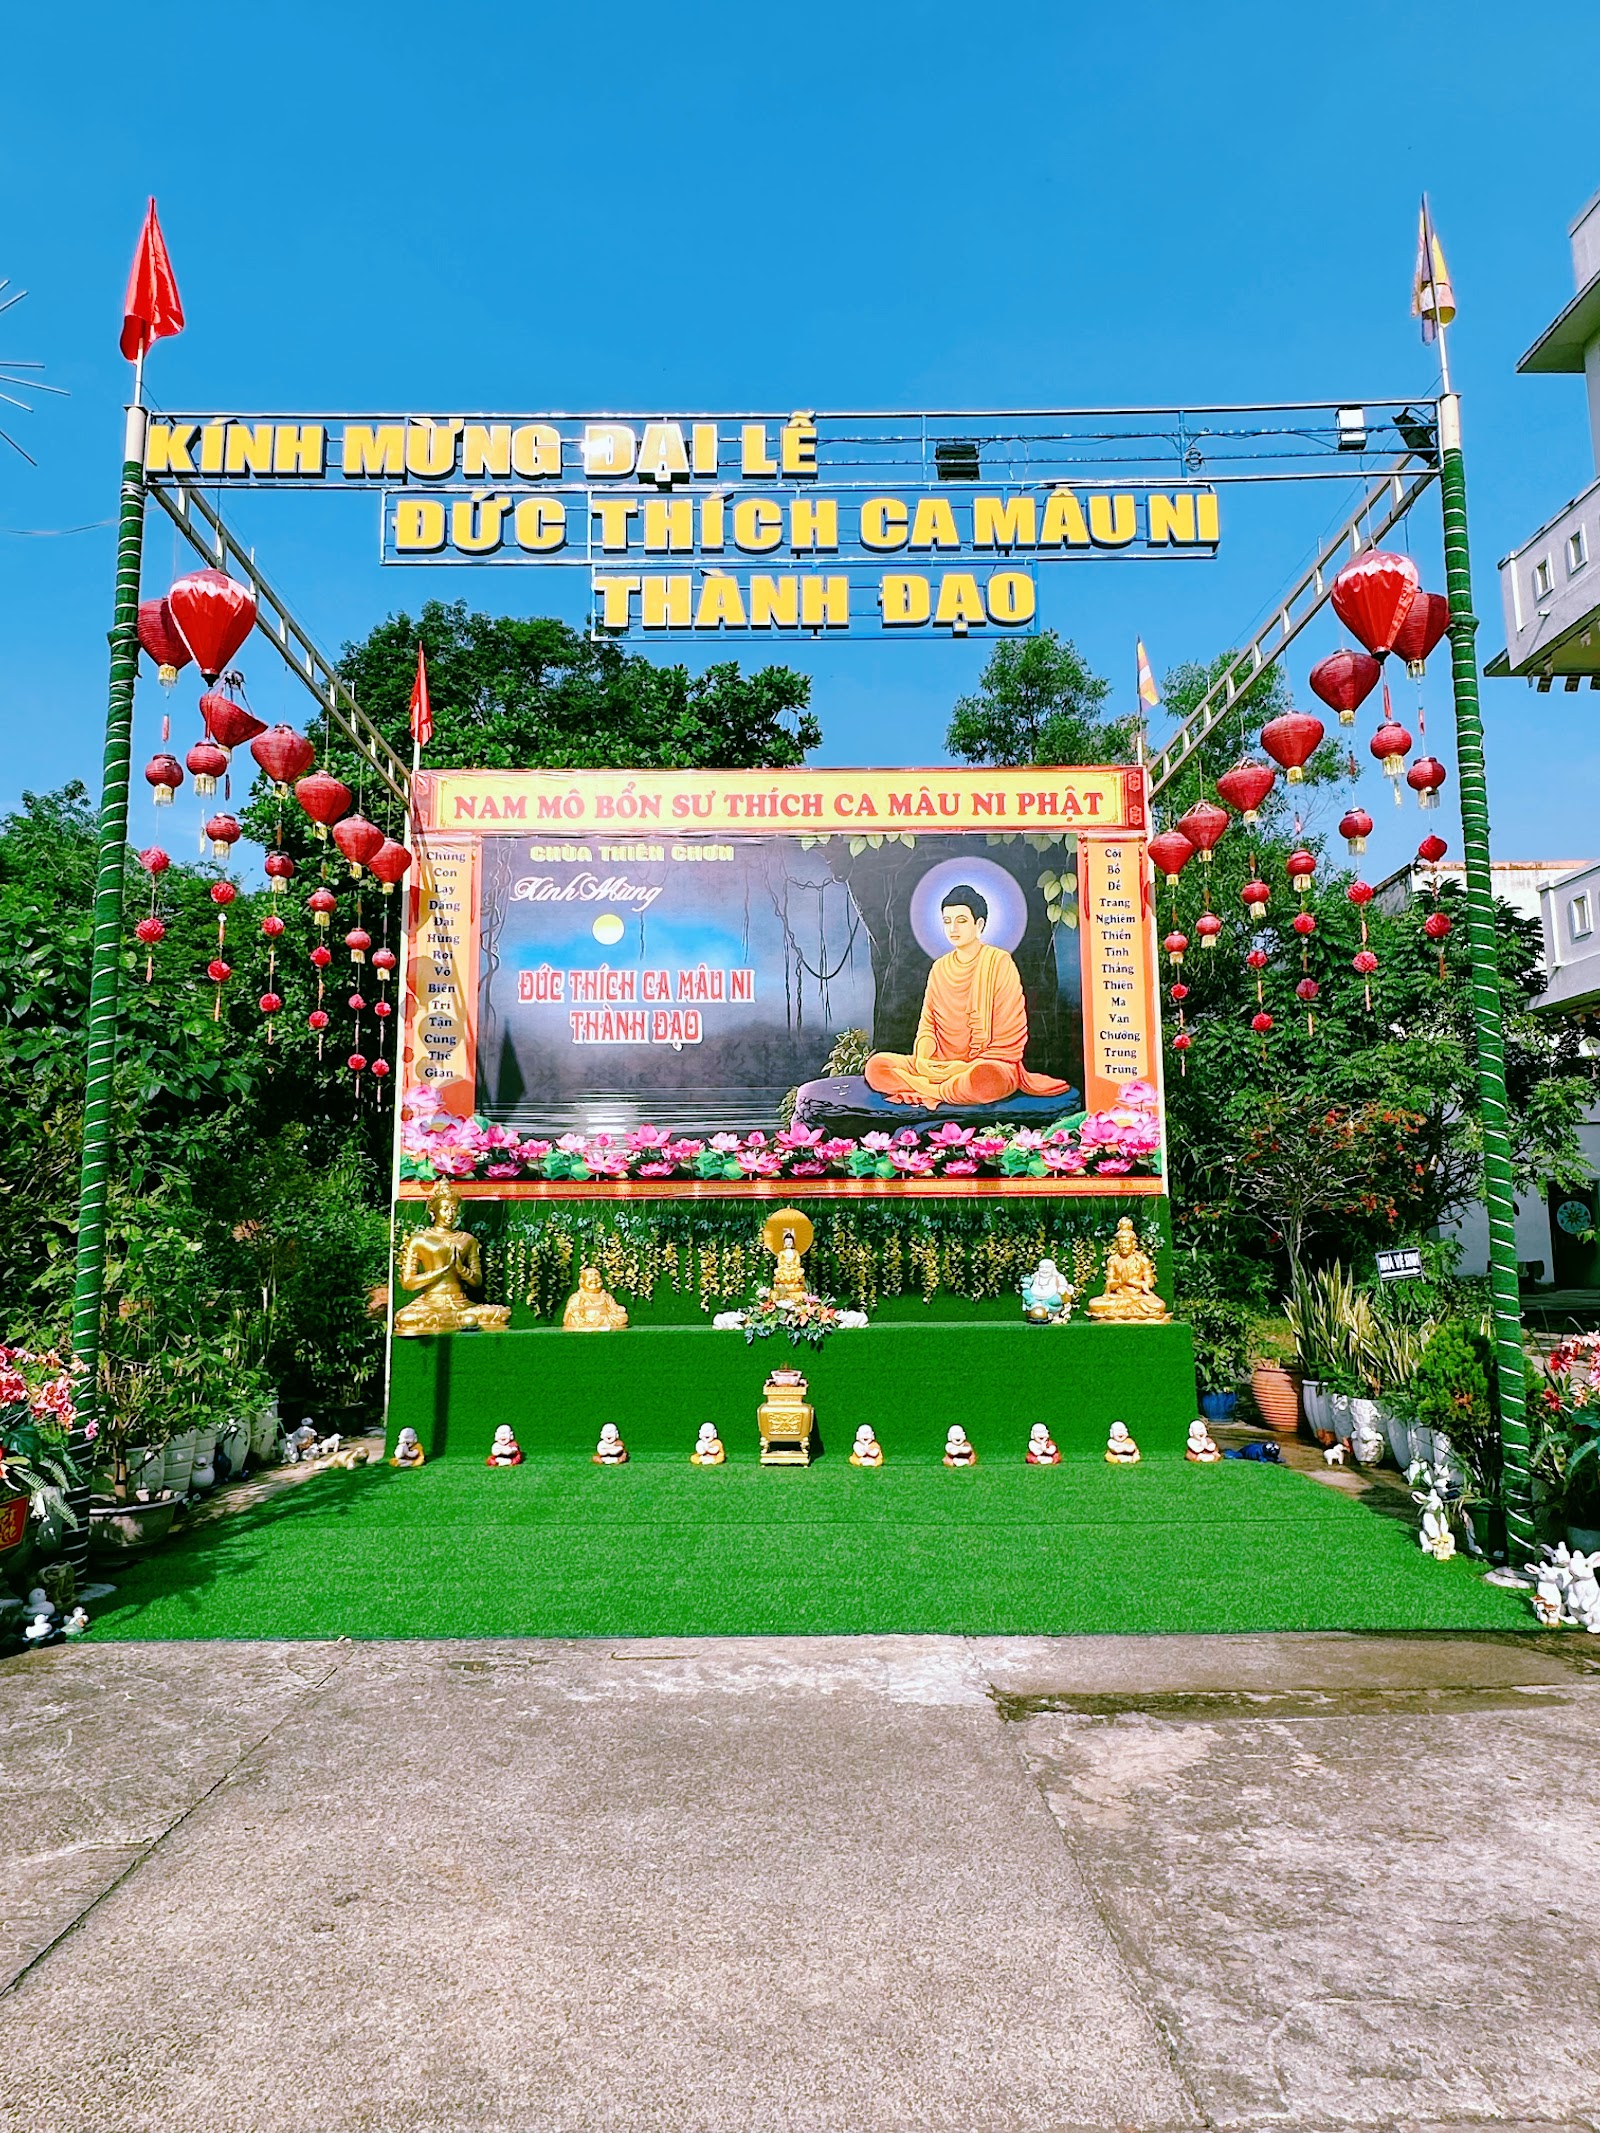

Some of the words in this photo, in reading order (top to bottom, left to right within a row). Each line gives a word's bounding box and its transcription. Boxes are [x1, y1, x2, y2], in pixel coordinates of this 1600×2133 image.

[145, 417, 326, 477] KÍNH
[342, 417, 564, 478] MỪNG
[580, 421, 719, 483] ĐẠI
[741, 410, 819, 480] LỄ
[392, 491, 567, 553] ĐỨC
[593, 492, 840, 554] THÍCH
[859, 497, 962, 551] CA
[973, 487, 1138, 547] MÂU
[1146, 492, 1221, 546] NI
[594, 568, 850, 631] THÀNH
[879, 571, 1037, 637] ĐẠO
[453, 794, 528, 819] NAM
[537, 788, 586, 819] MÔ
[594, 781, 663, 819] BỔN
[671, 790, 717, 818] SƯ
[723, 786, 825, 818] THÍCH
[833, 792, 879, 817] CA
[887, 785, 961, 817] MÂU
[972, 792, 1006, 817] NI
[1016, 785, 1104, 822] PHẬT
[426, 850, 466, 863] Chúng
[529, 843, 593, 862] CHÙA
[598, 843, 665, 862] THIÊN
[671, 844, 735, 862] CHƠN
[433, 867, 457, 877] Con
[509, 872, 591, 902] Kính
[579, 876, 663, 912] Mừng
[1099, 897, 1131, 909] Trang
[427, 933, 460, 945] Hùng
[434, 966, 451, 977] Vô
[428, 983, 455, 993] Biên
[518, 963, 565, 1004] ĐỨC
[568, 963, 638, 1004] THÍCH
[641, 969, 674, 1004] CA
[676, 963, 728, 1004] MÂU
[729, 969, 756, 1004] NI
[432, 999, 451, 1010] Trí
[1111, 997, 1126, 1007] Ma
[569, 1002, 650, 1045] THÀNH
[651, 1009, 703, 1051] ĐẠO
[428, 1049, 453, 1061] Thế
[424, 1067, 454, 1078] Gian
